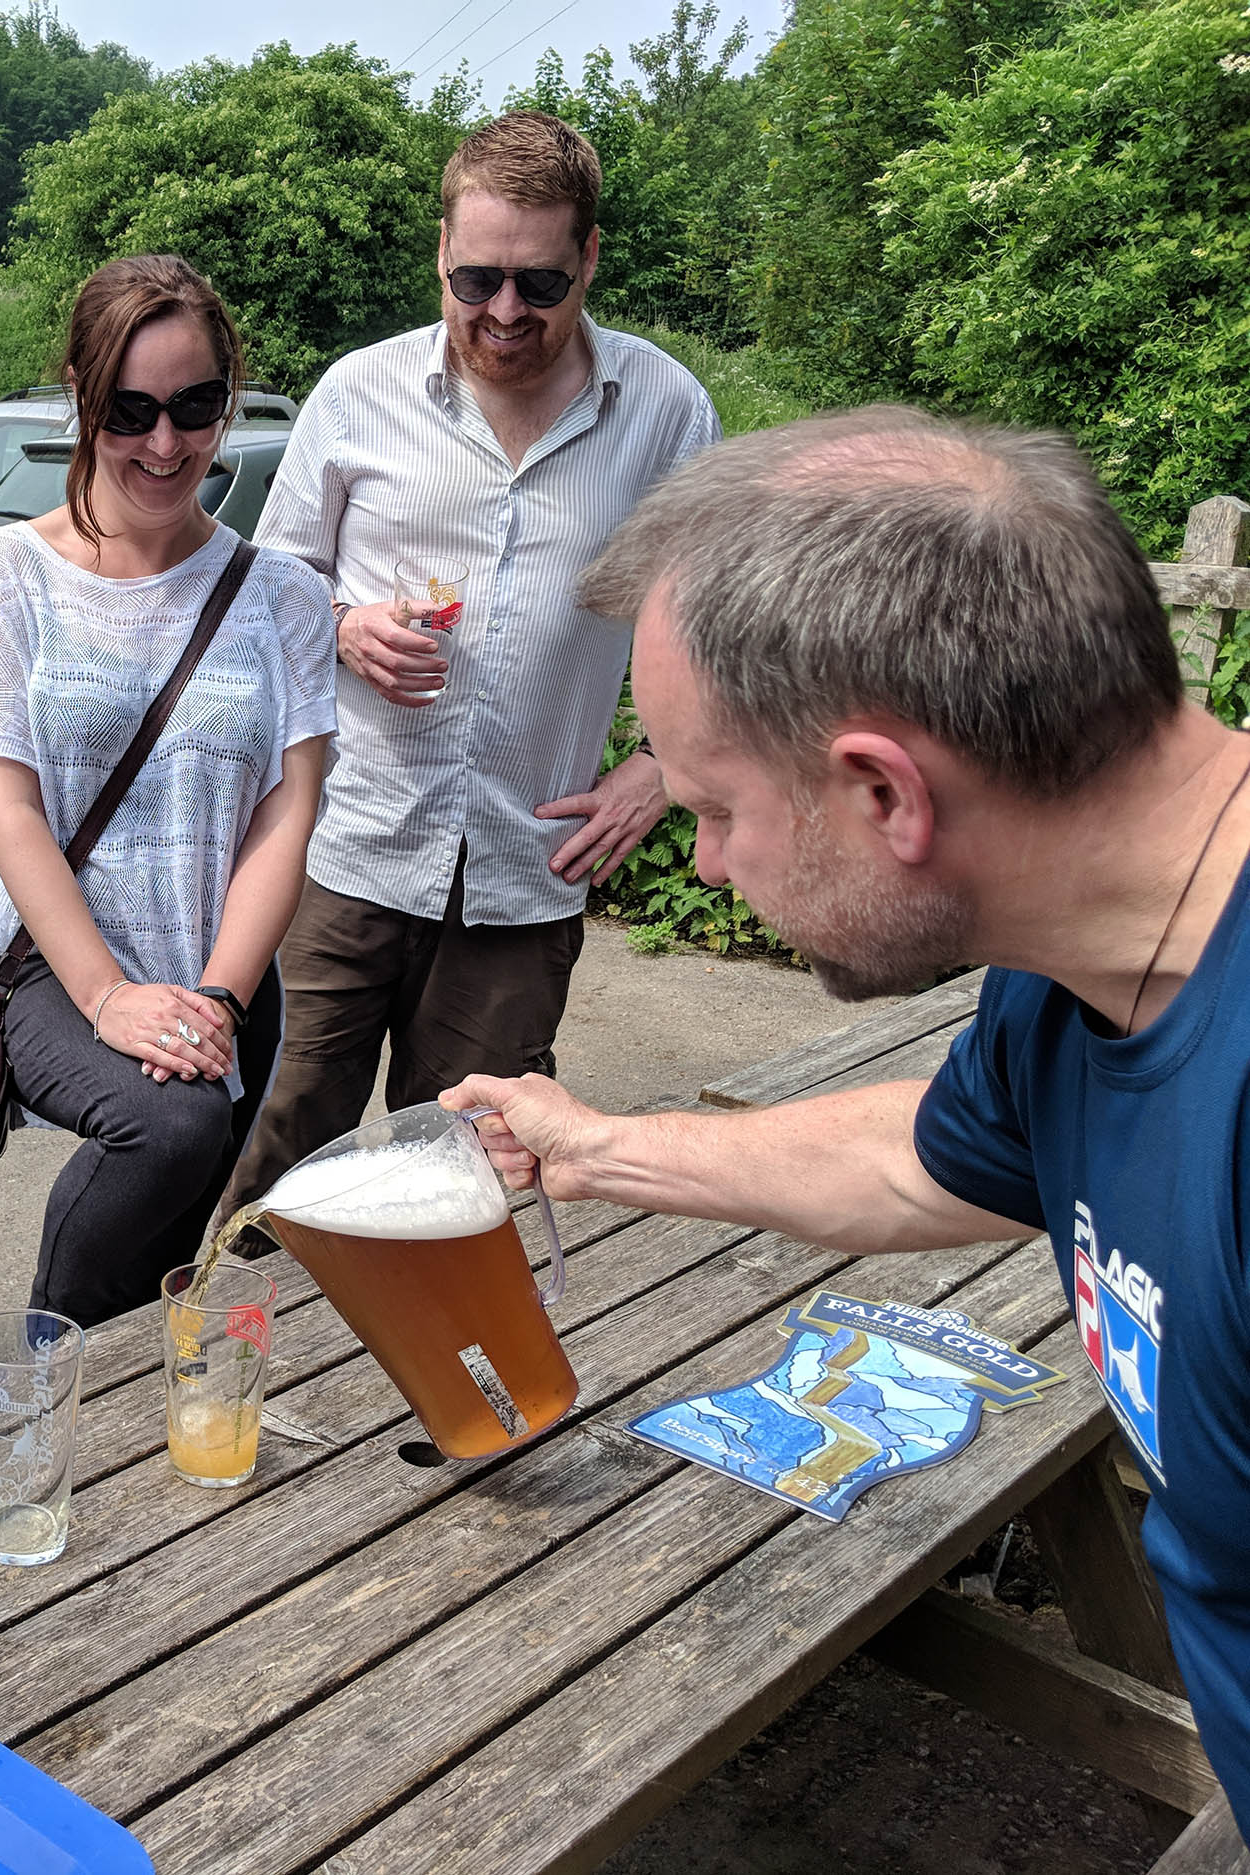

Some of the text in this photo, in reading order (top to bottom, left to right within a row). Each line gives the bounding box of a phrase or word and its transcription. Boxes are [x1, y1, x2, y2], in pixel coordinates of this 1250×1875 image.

[823, 1298, 1039, 1378] FALLS GOLD
[882, 1301, 1009, 1351] Tillingbourne
